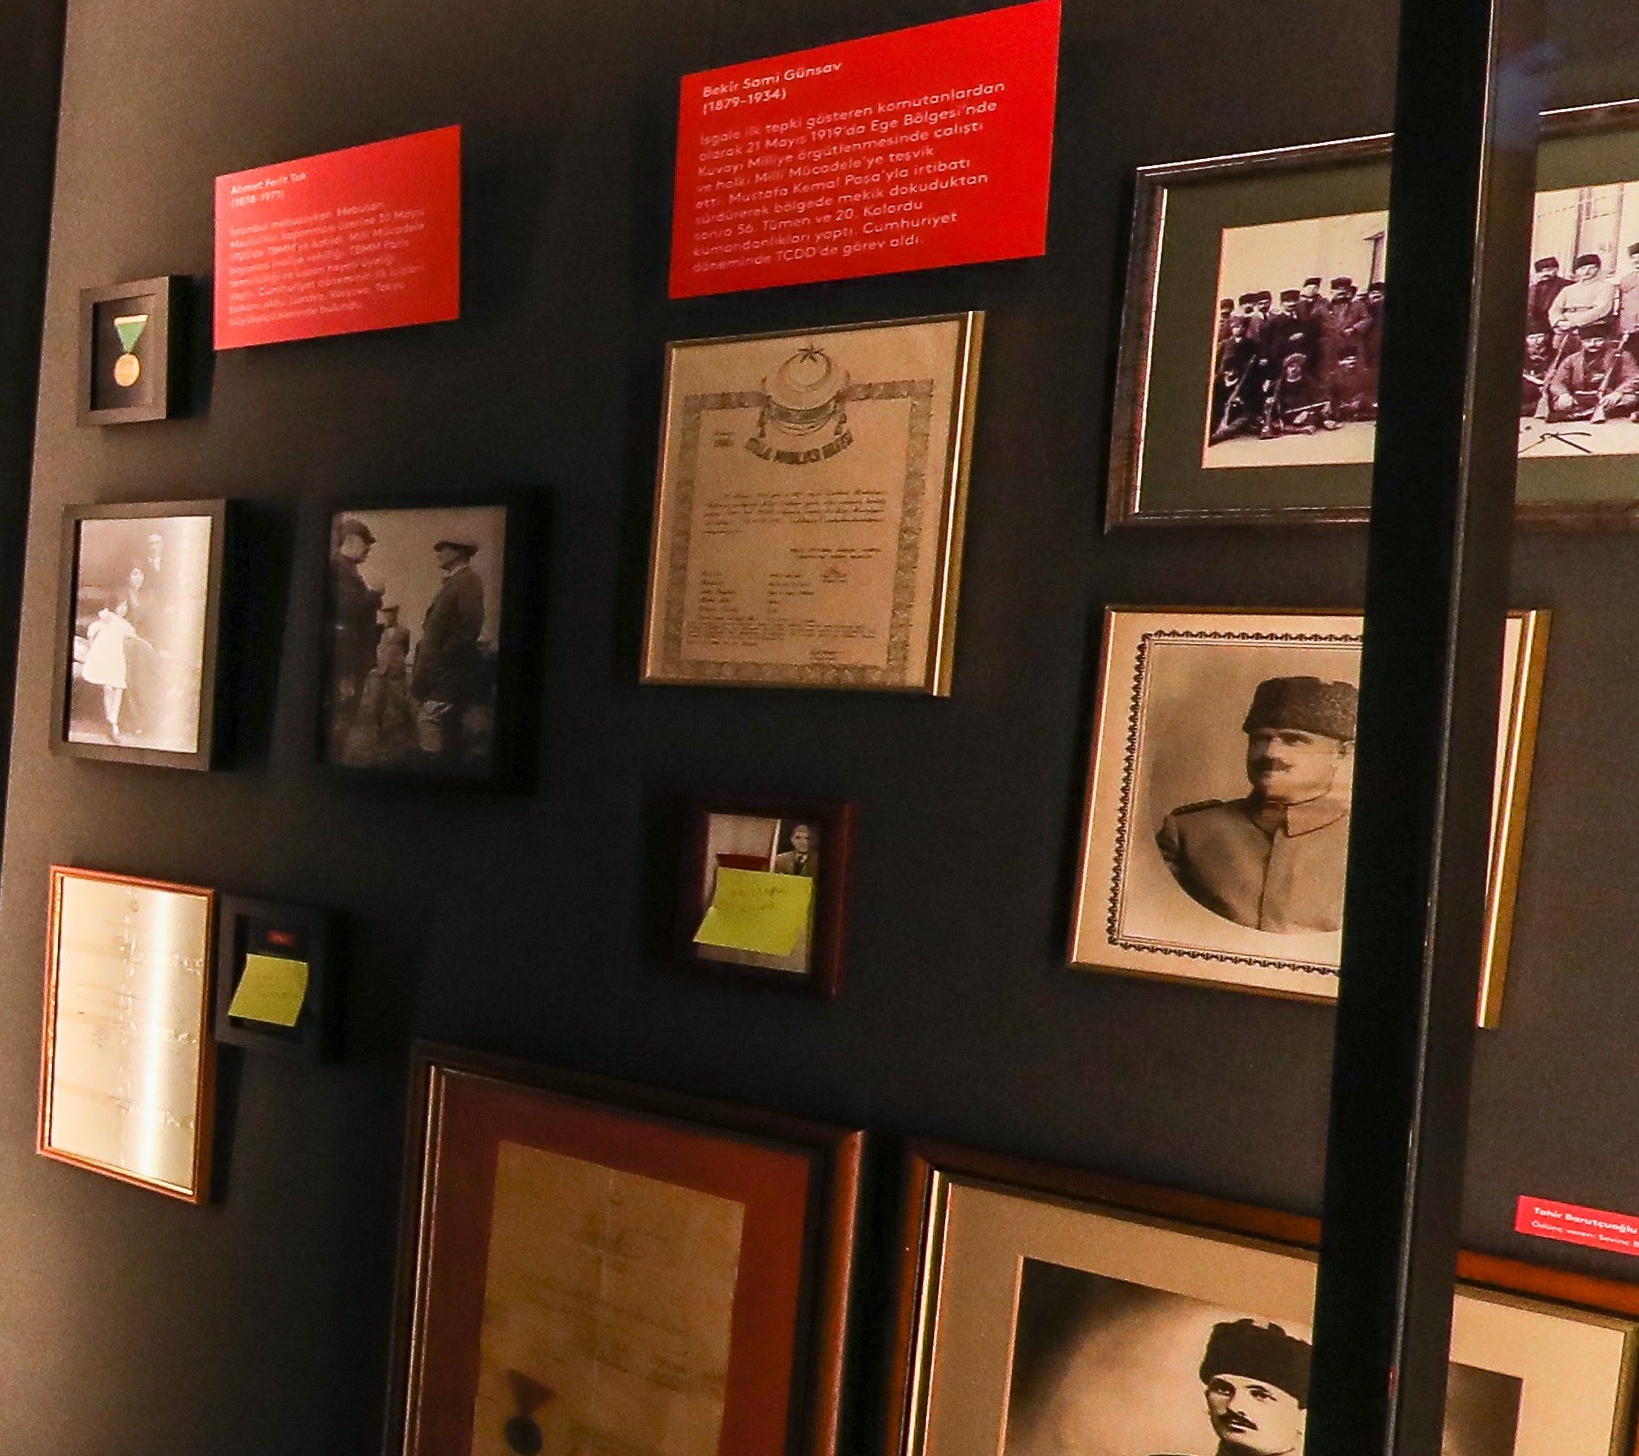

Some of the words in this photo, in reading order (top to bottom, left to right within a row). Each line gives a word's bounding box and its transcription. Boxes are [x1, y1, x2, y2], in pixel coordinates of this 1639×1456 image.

[701, 79, 739, 98] Bekir
[741, 71, 780, 89] Sami
[783, 61, 842, 81] Günsav
[702, 87, 787, 115] (1879-1934)
[764, 116, 802, 133] tepki
[805, 106, 873, 130] gösteren
[877, 82, 1005, 113] komutanlardan
[698, 144, 742, 162] olarak
[745, 139, 761, 154] 21
[810, 124, 866, 141] 1919'da
[869, 118, 898, 134] Ege
[903, 100, 997, 126] Bölgesi'nde
[797, 130, 928, 161] örgütlenmesinde
[888, 144, 934, 162] teşvik
[728, 187, 788, 204] Mustafa
[792, 176, 840, 194] Kemal
[773, 195, 833, 213] bölgede
[837, 187, 884, 203] mekik
[888, 173, 988, 196] dokuduktan
[761, 216, 811, 231] Tümen
[814, 213, 832, 223] ve
[862, 199, 923, 216] Kolordu
[861, 211, 957, 234] Cumhuriyet
[842, 239, 886, 257] görev
[1533, 1206, 1563, 1219] Tahir
[1564, 1212, 1638, 1234] Barutçuoğlu
